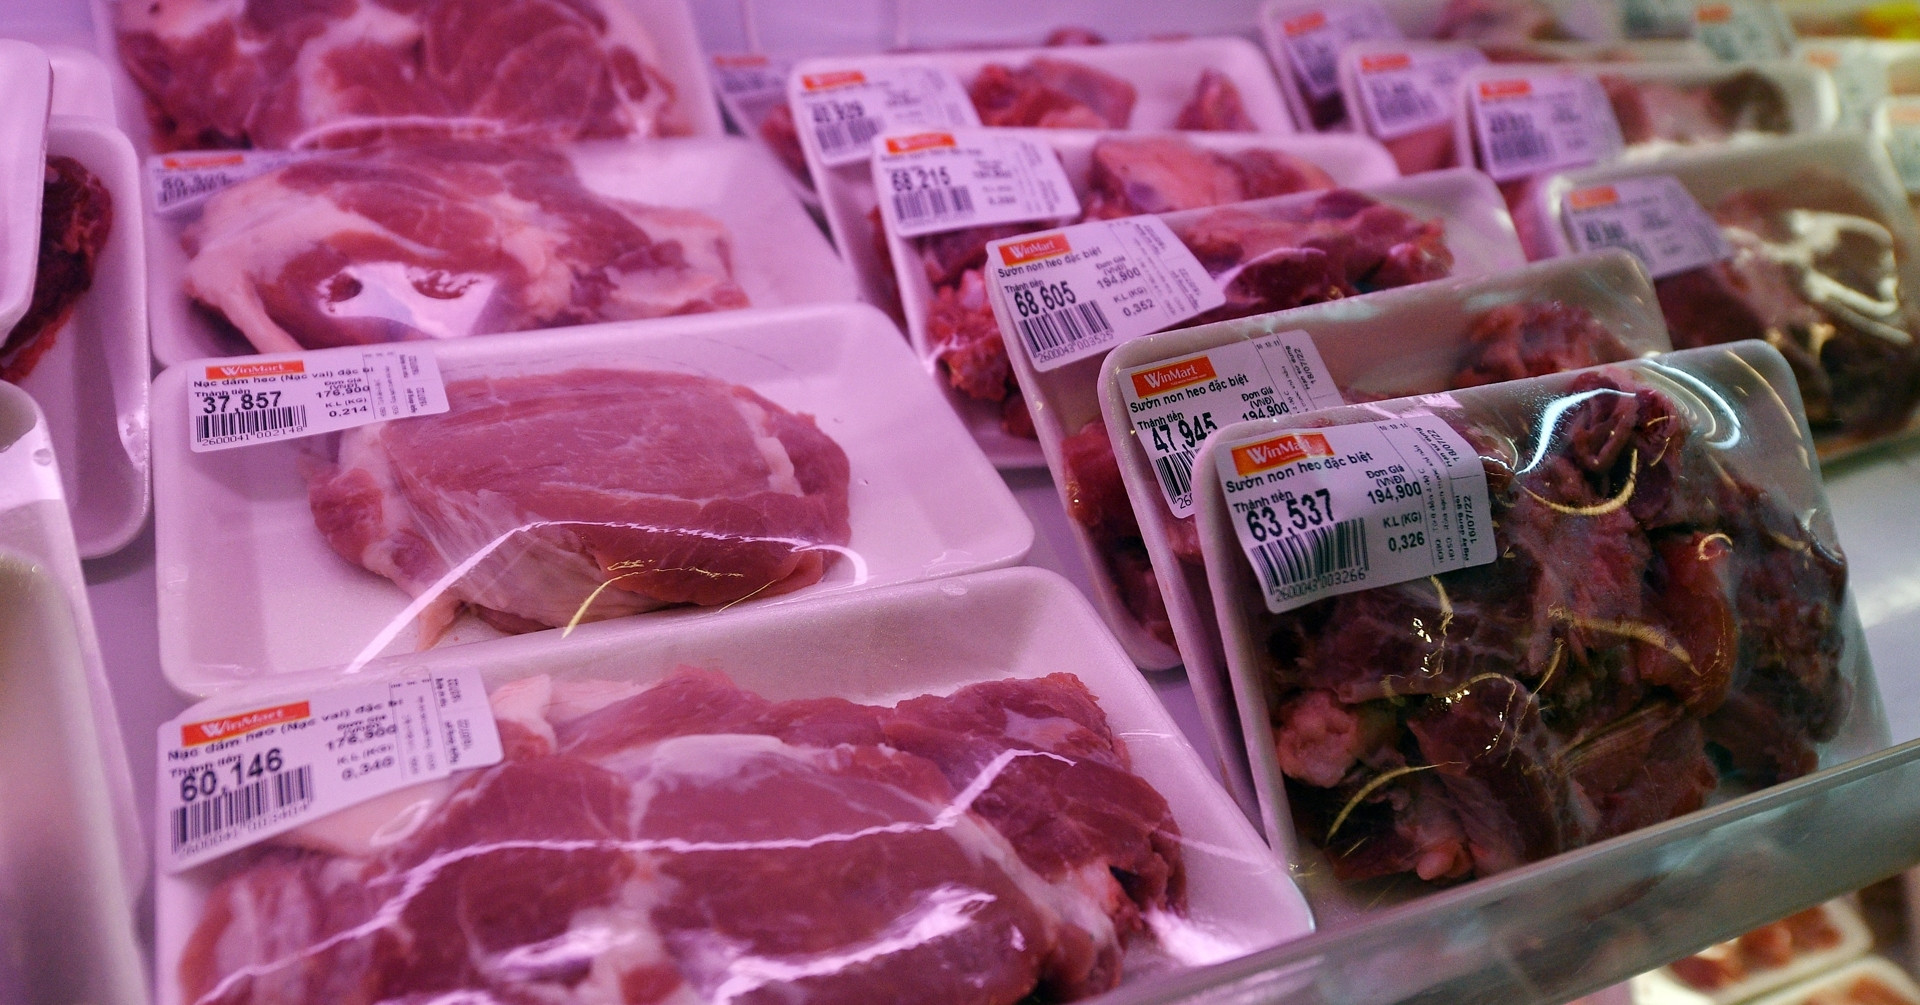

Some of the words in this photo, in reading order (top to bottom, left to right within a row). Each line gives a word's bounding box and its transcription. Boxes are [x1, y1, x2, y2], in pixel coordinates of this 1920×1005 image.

[1009, 240, 1056, 259] WinMart
[1026, 262, 1044, 273] non
[1045, 258, 1063, 268] heo
[1014, 281, 1076, 318] 68,605
[220, 364, 284, 376] WinMart
[1144, 364, 1198, 389] WinMart
[203, 391, 281, 416] 37,857
[1130, 397, 1161, 413] Sườn
[1163, 391, 1184, 403] non
[1186, 388, 1206, 399] heo
[1208, 379, 1228, 393] đặc
[1229, 373, 1249, 387] biệt
[1250, 395, 1275, 410] (VNĐ)
[1137, 415, 1167, 431] Thành
[202, 434, 250, 447] 2600041
[256, 426, 304, 439] 002148
[1226, 475, 1264, 493] Sườn
[1267, 468, 1295, 483] non
[1297, 462, 1321, 474] heo
[1324, 456, 1346, 470] đặc
[1347, 451, 1373, 464] biệt
[1365, 469, 1387, 479] Đơn
[1388, 464, 1405, 474] Giá
[1376, 474, 1406, 488] (VNĐ)
[1233, 496, 1270, 513] Thành
[1270, 489, 1294, 503] tiền
[1367, 481, 1422, 504] 194,900
[1246, 488, 1335, 541] 63,537
[1401, 512, 1422, 526] (KG)
[1464, 495, 1477, 544] 16/07/22
[1388, 531, 1425, 553] 0,326
[1320, 567, 1366, 588] 003266
[201, 709, 284, 738] WinMart
[245, 727, 275, 743] heo
[181, 748, 283, 803] 60,146
